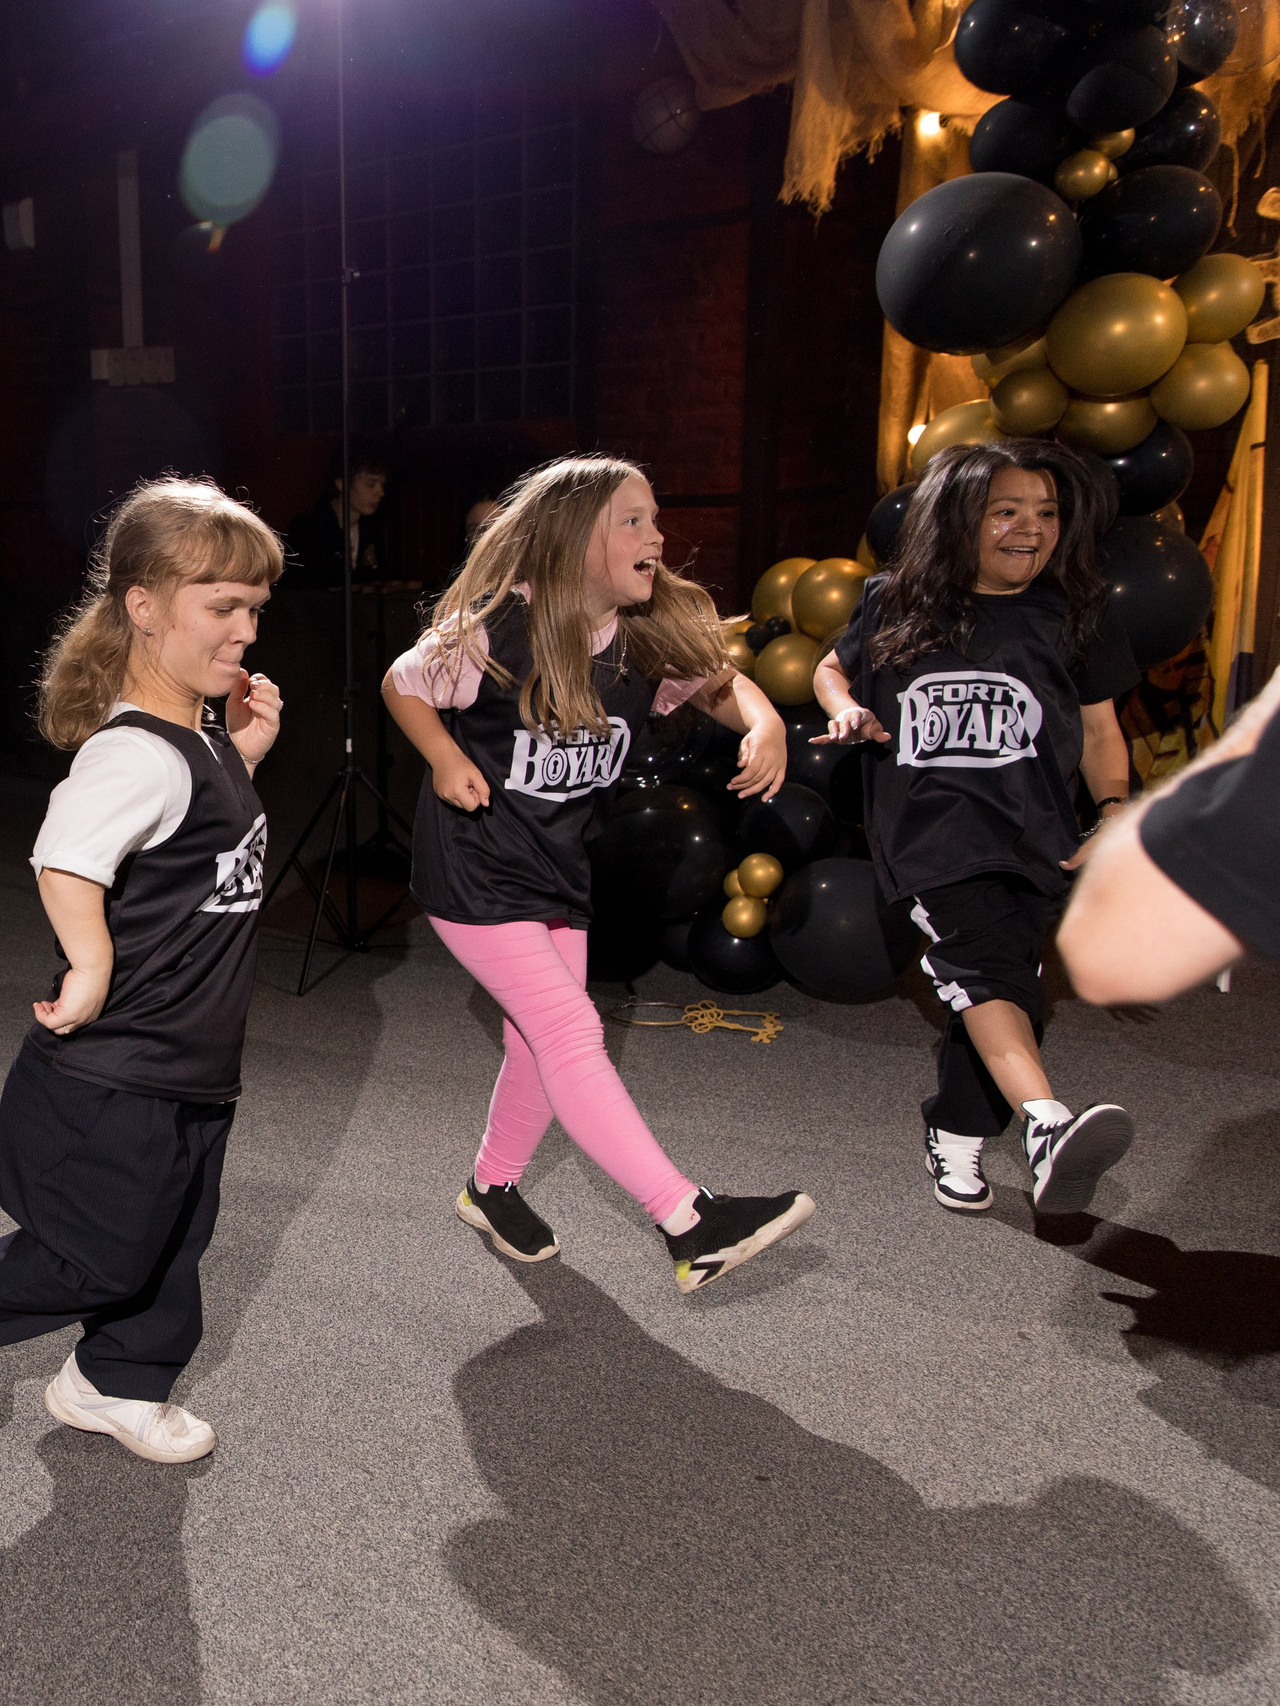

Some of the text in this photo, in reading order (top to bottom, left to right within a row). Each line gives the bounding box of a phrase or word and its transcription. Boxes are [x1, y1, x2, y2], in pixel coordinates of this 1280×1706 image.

[927, 683, 1009, 704] FORT
[552, 728, 609, 746] FOR
[896, 688, 1043, 767] BOYARD
[504, 727, 631, 790] BOYARD
